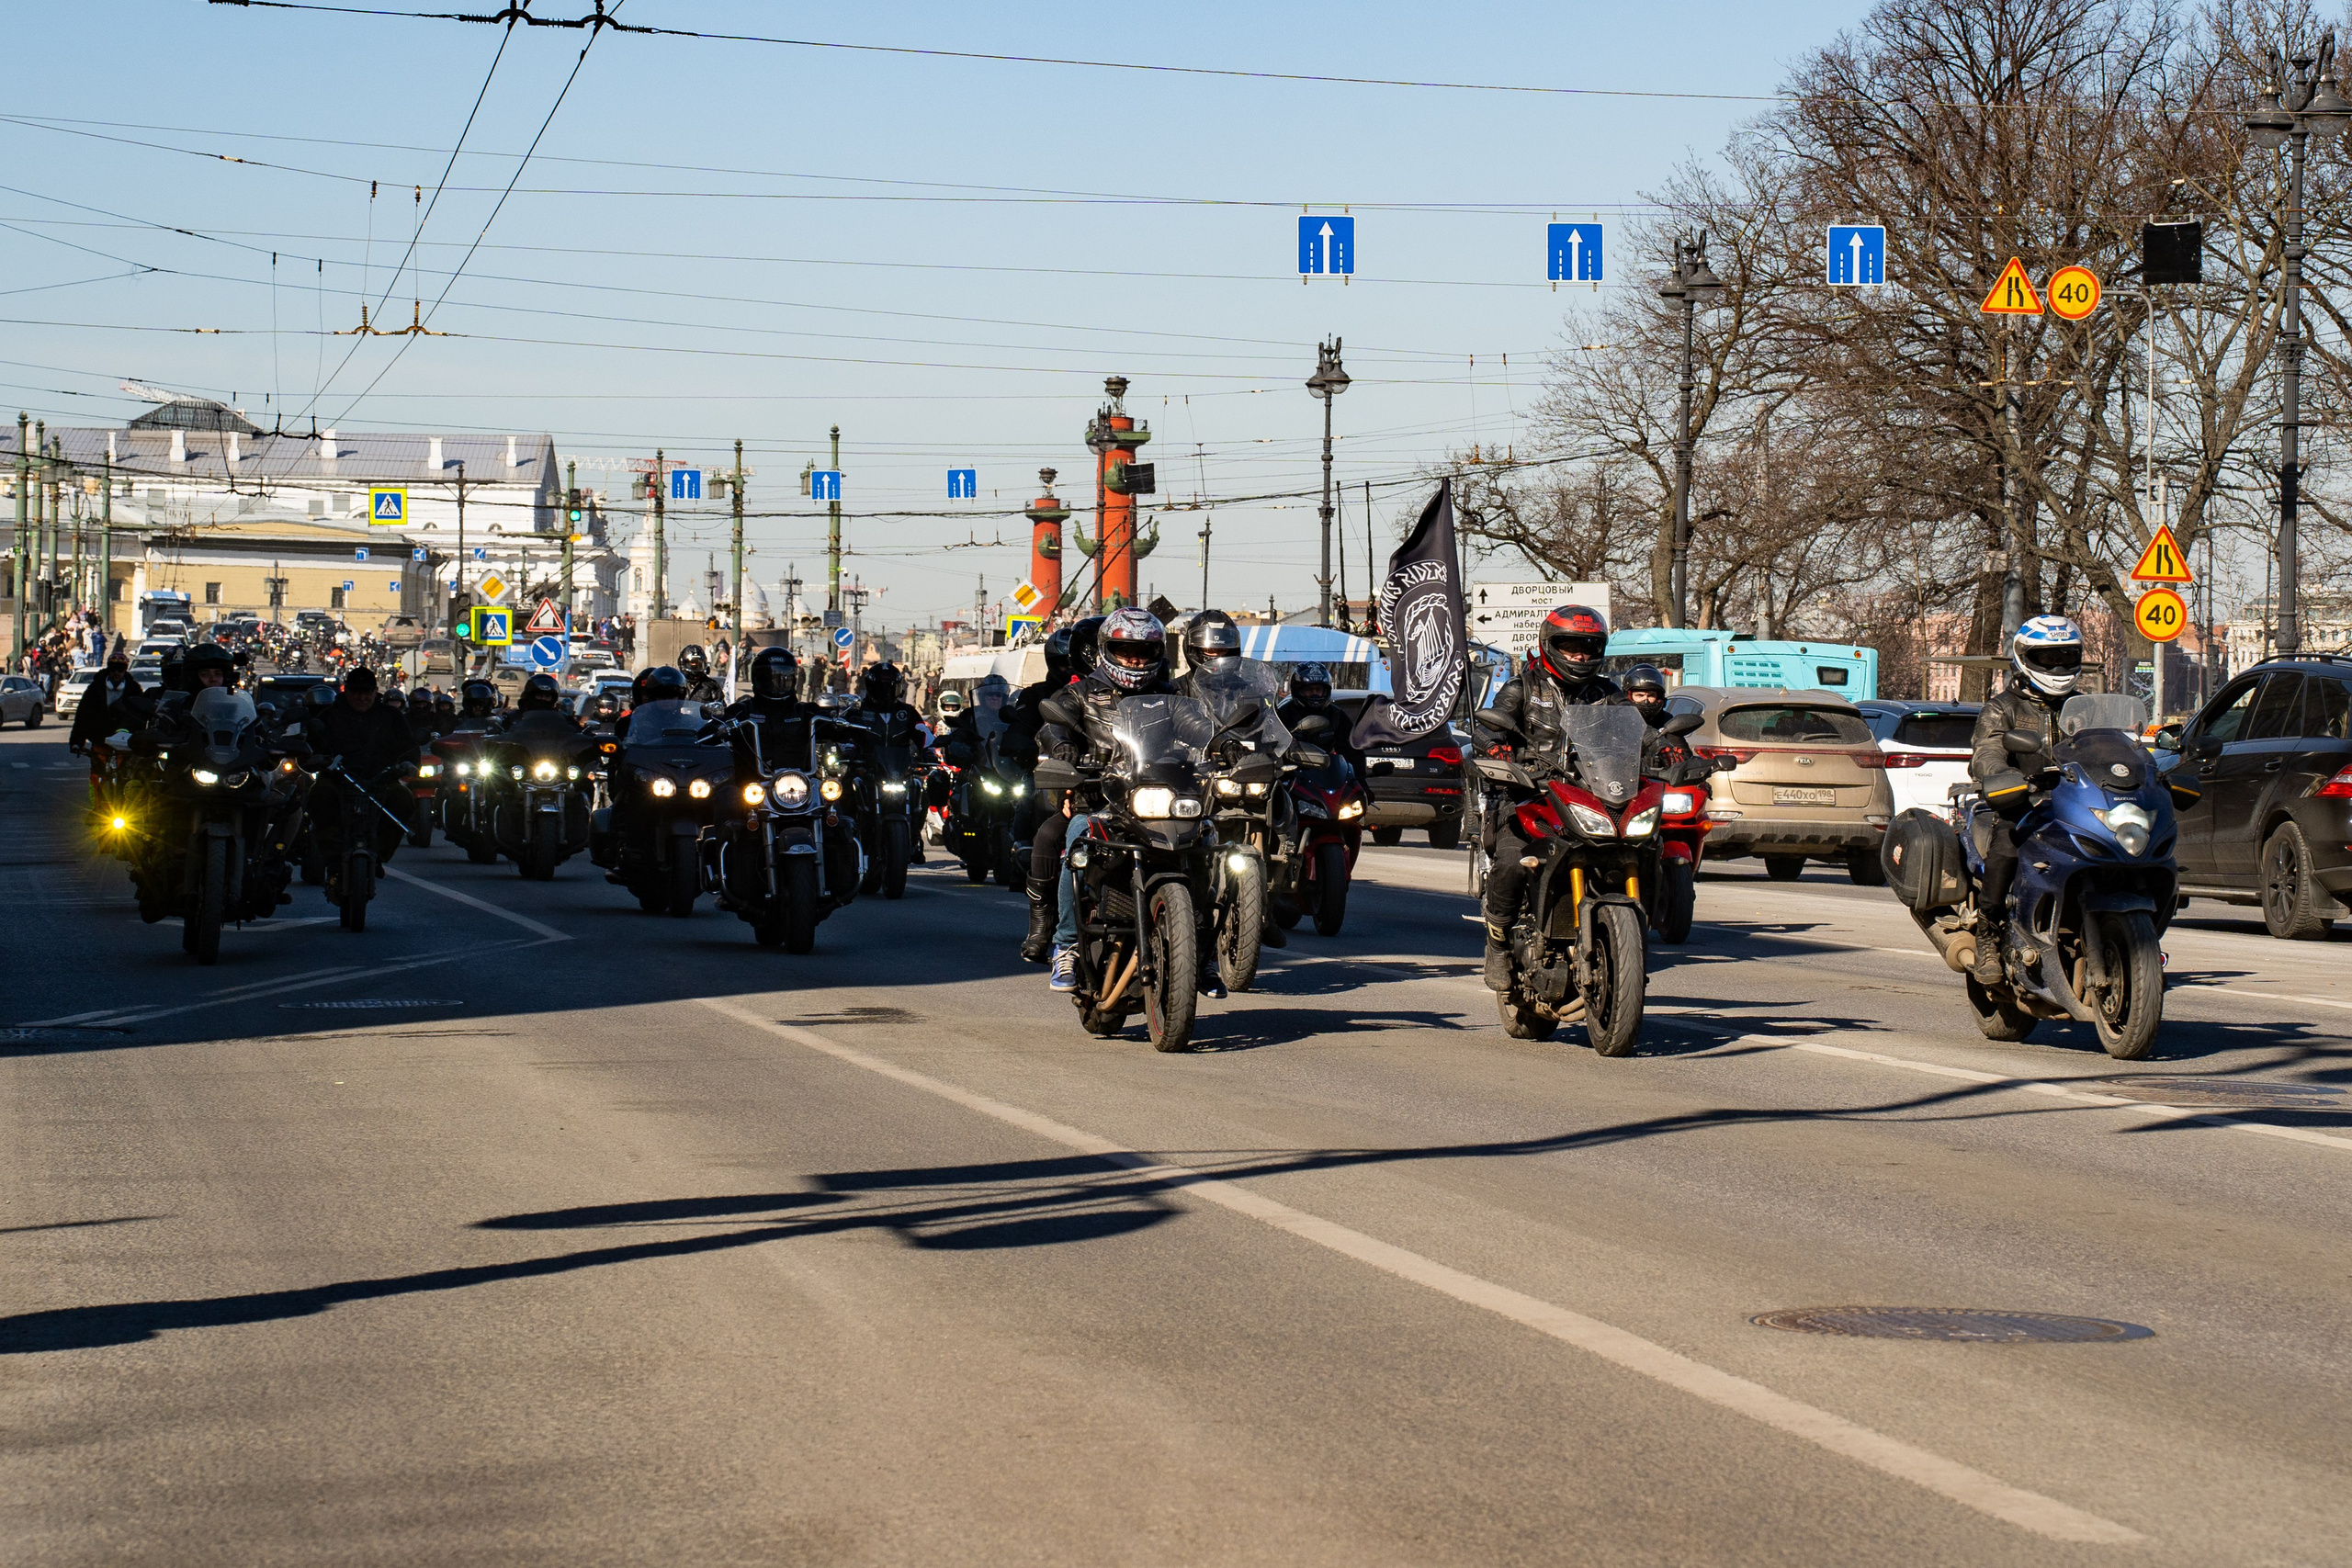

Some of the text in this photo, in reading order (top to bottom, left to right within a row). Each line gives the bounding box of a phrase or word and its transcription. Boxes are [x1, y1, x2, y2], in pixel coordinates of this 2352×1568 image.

[2058, 282, 2088, 303] 40
[1395, 561, 1448, 588] RIDERS
[1510, 583, 1574, 595] ДВОРЦОВЫЙ
[2145, 604, 2176, 626] 40
[1513, 620, 1541, 629] набер
[1511, 633, 1539, 642] ДВОР
